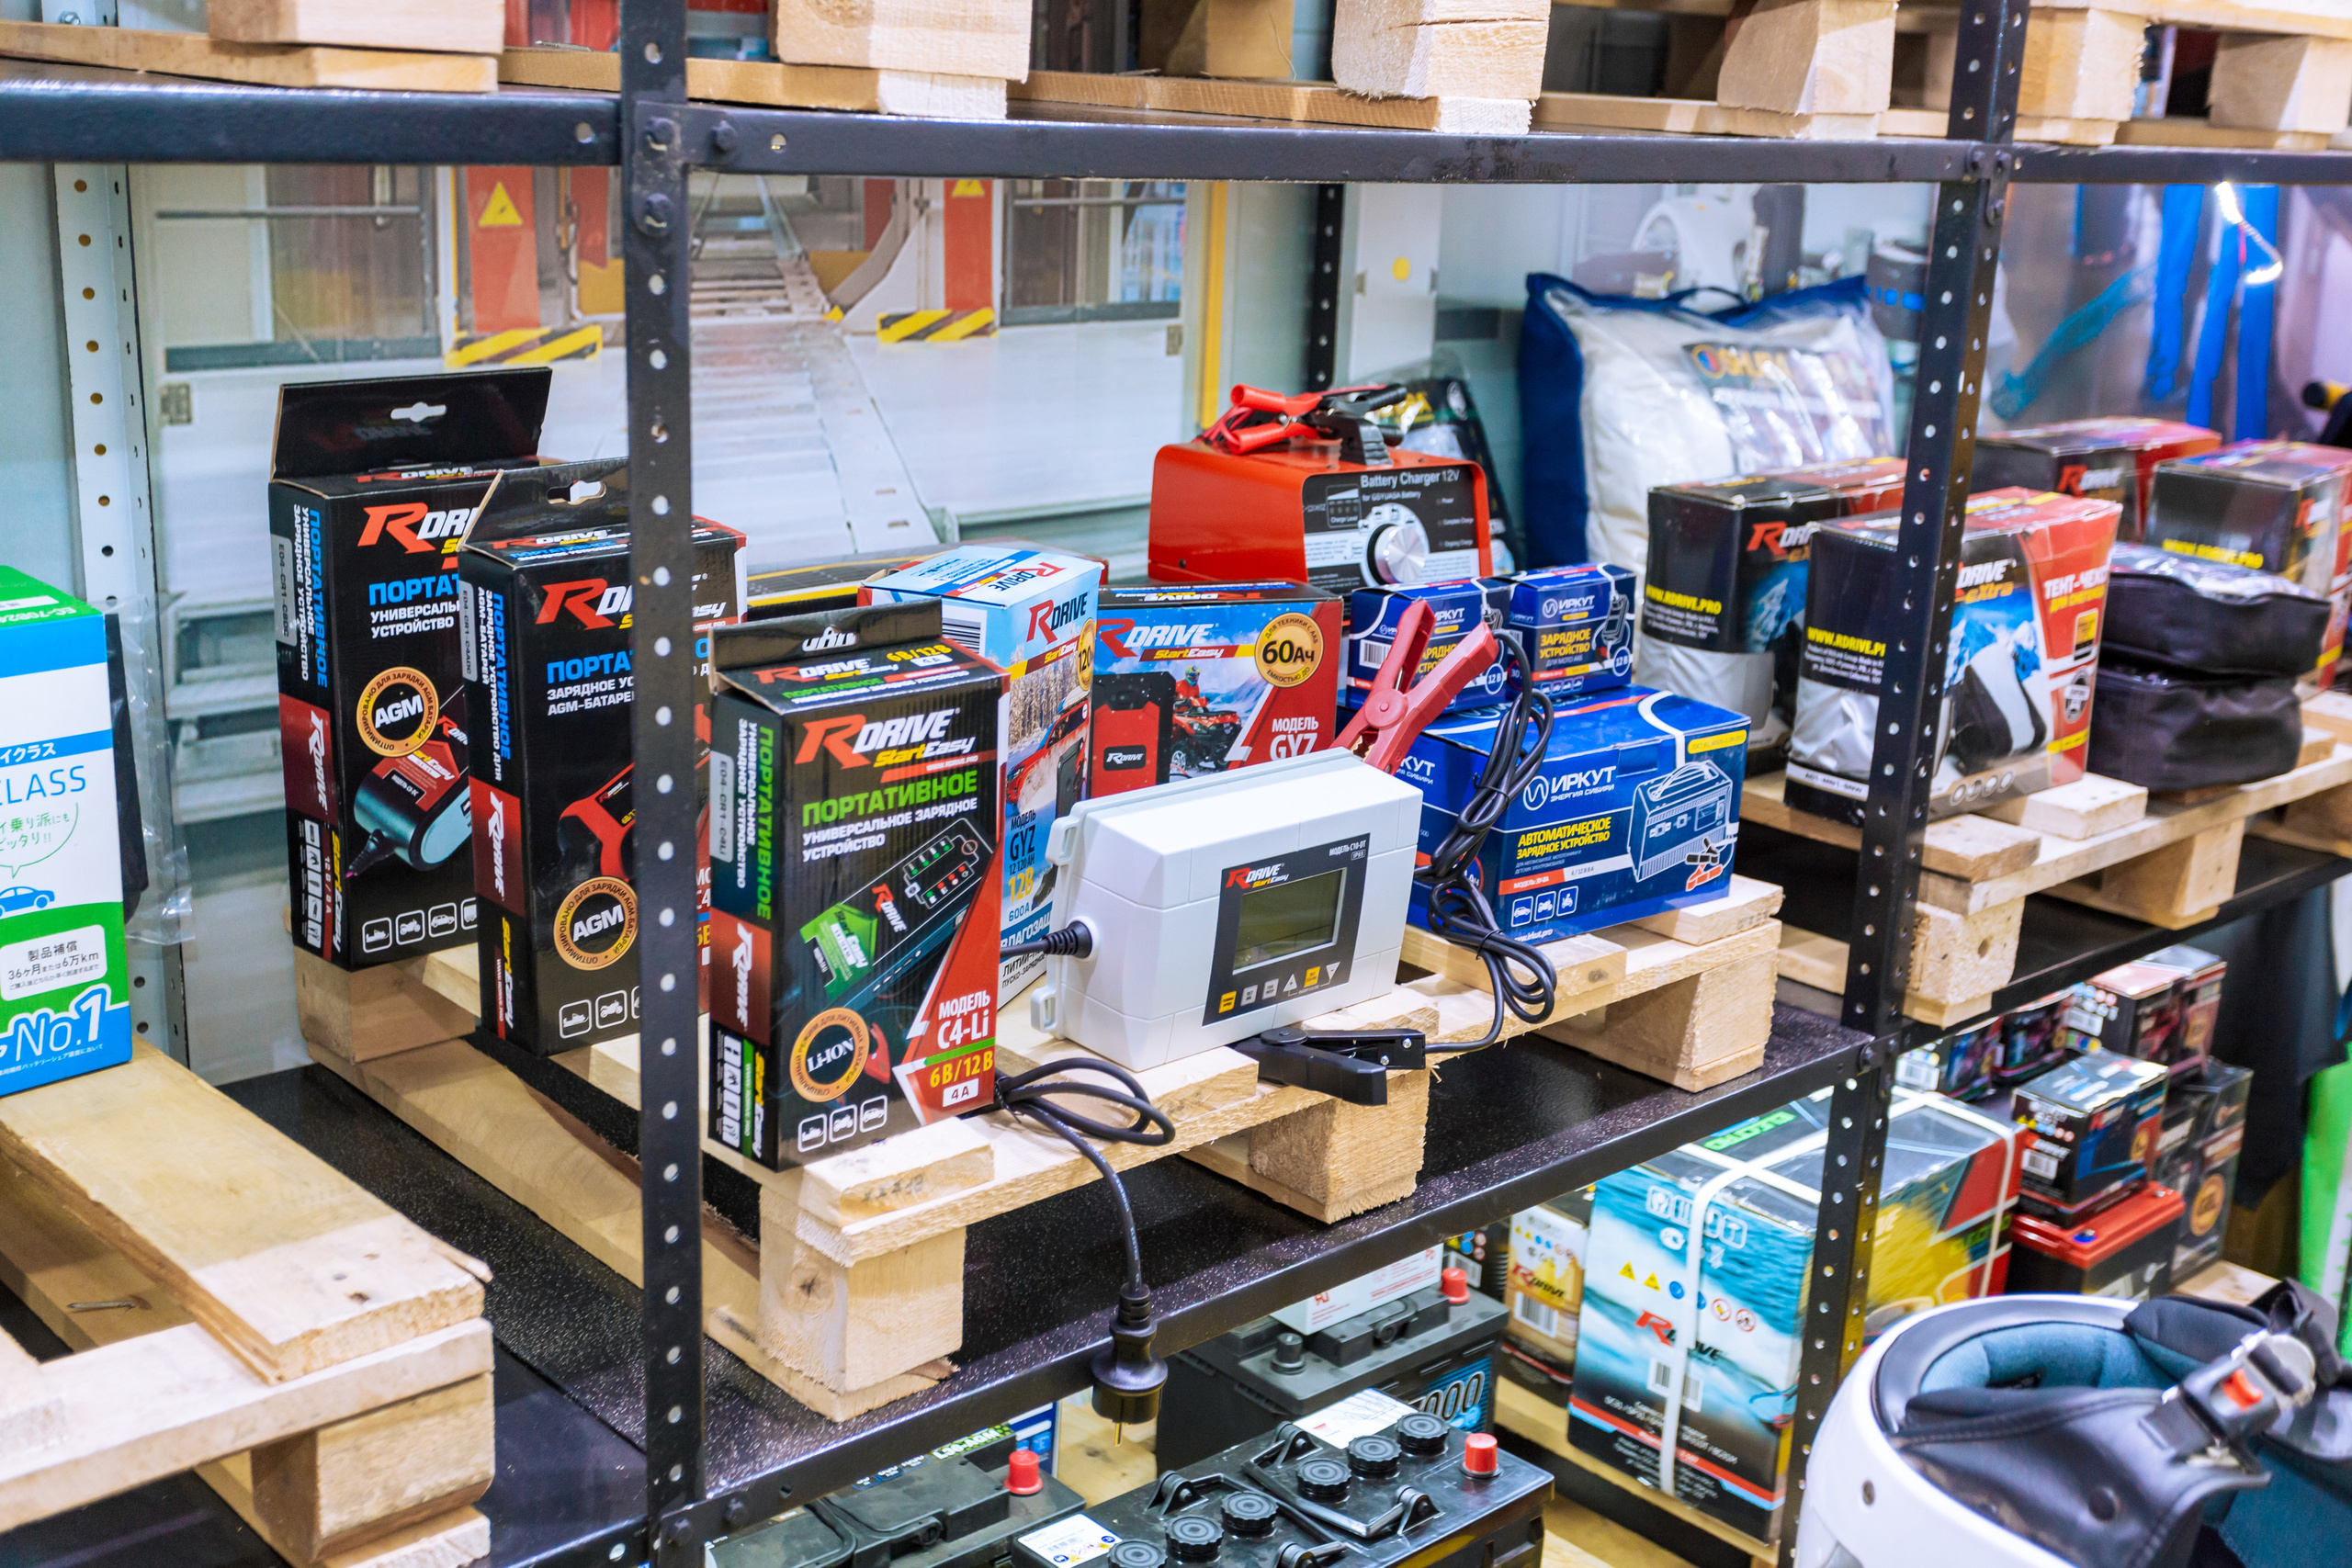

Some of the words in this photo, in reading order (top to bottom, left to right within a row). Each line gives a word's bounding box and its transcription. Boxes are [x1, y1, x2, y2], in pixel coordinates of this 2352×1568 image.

[1360, 475, 1398, 490] Battery
[1399, 471, 1441, 487] Charger
[1442, 468, 1460, 482] 12V
[1956, 558, 2009, 592] DRIVE
[310, 509, 328, 688] ПОРТАТИВНОЕ
[1559, 595, 1596, 610] ИРКУТ
[1966, 581, 2015, 604] eXtra
[371, 616, 454, 639] УСТРОЙСТВО
[1026, 592, 1089, 646] RDRIVE
[1265, 625, 1277, 639] ДЛЯ
[1278, 617, 1308, 627] ТЕХНИКИ
[1044, 640, 1078, 664] StartEasy
[1096, 618, 1214, 659] RDRIVE
[1539, 642, 1590, 660] УСТРОЙСТВО
[1540, 627, 1591, 647] ЗАРЯДНОЕ
[1153, 648, 1225, 660] StartEasy
[492, 593, 512, 760] ПОРТАТИВНОЕ
[752, 658, 871, 684] RDRIVE
[547, 679, 616, 701] ЗАРЯДНОЕ
[375, 694, 424, 728] AGM
[1272, 716, 1319, 733] МОДЕЛЬ
[795, 708, 956, 770] RDRIVE
[874, 737, 976, 768] StartEasy
[1106, 751, 1144, 765] RDRIVE
[1399, 755, 1435, 777] КУТ
[0, 765, 85, 807] LASS
[1550, 765, 1617, 795] ИРКУТ
[1550, 791, 1584, 803] ЭНЕРГИЯ
[1584, 784, 1615, 796] СИБИРИ
[803, 770, 978, 827] ПОРТАТИВНОЕ
[757, 726, 775, 920] ПОРТАТИВНОЕ
[803, 812, 912, 846] УНИВЕРСАЛЬНОЕ
[915, 797, 978, 822] ЗАРЯДНОЕ
[1011, 808, 1036, 831] МОДЕЛЬ
[1518, 817, 1612, 847] АВТОМАТИЧЕСКОЕ
[803, 833, 886, 863] УСТРОЙСТВО
[1010, 825, 1036, 862] GYZ
[1516, 840, 1559, 860] ЗАРЯДНОЕ
[1560, 830, 1611, 851] УСТРОЙСТВО
[1008, 866, 1035, 904] 12В
[1226, 863, 1282, 888] RDRIVE
[1252, 873, 1290, 889] StartEasy
[872, 883, 908, 932] RDRIVE
[573, 904, 625, 942] AGM
[28, 941, 78, 962] 製品補償
[938, 990, 990, 1021] МОДЕЛЬ
[937, 1009, 989, 1050] C4-Li
[1511, 1263, 1566, 1300] RDRIVE
